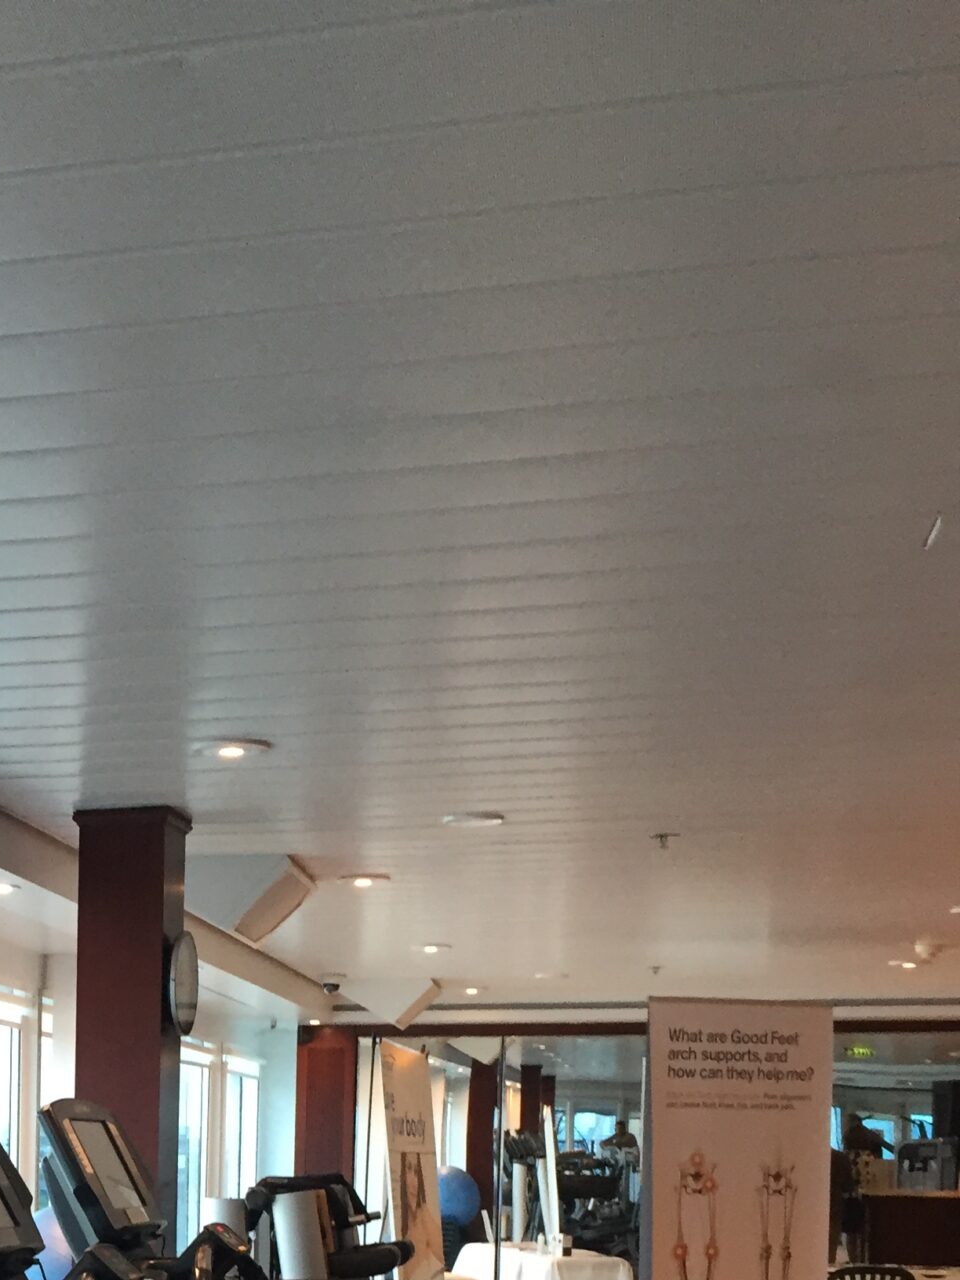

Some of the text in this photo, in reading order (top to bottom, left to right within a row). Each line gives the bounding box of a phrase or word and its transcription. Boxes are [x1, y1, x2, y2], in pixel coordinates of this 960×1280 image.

[668, 1028, 799, 1045] What are Good Feet
[668, 1046, 788, 1063] arch supports, and
[667, 1065, 815, 1083] how can they help me?
